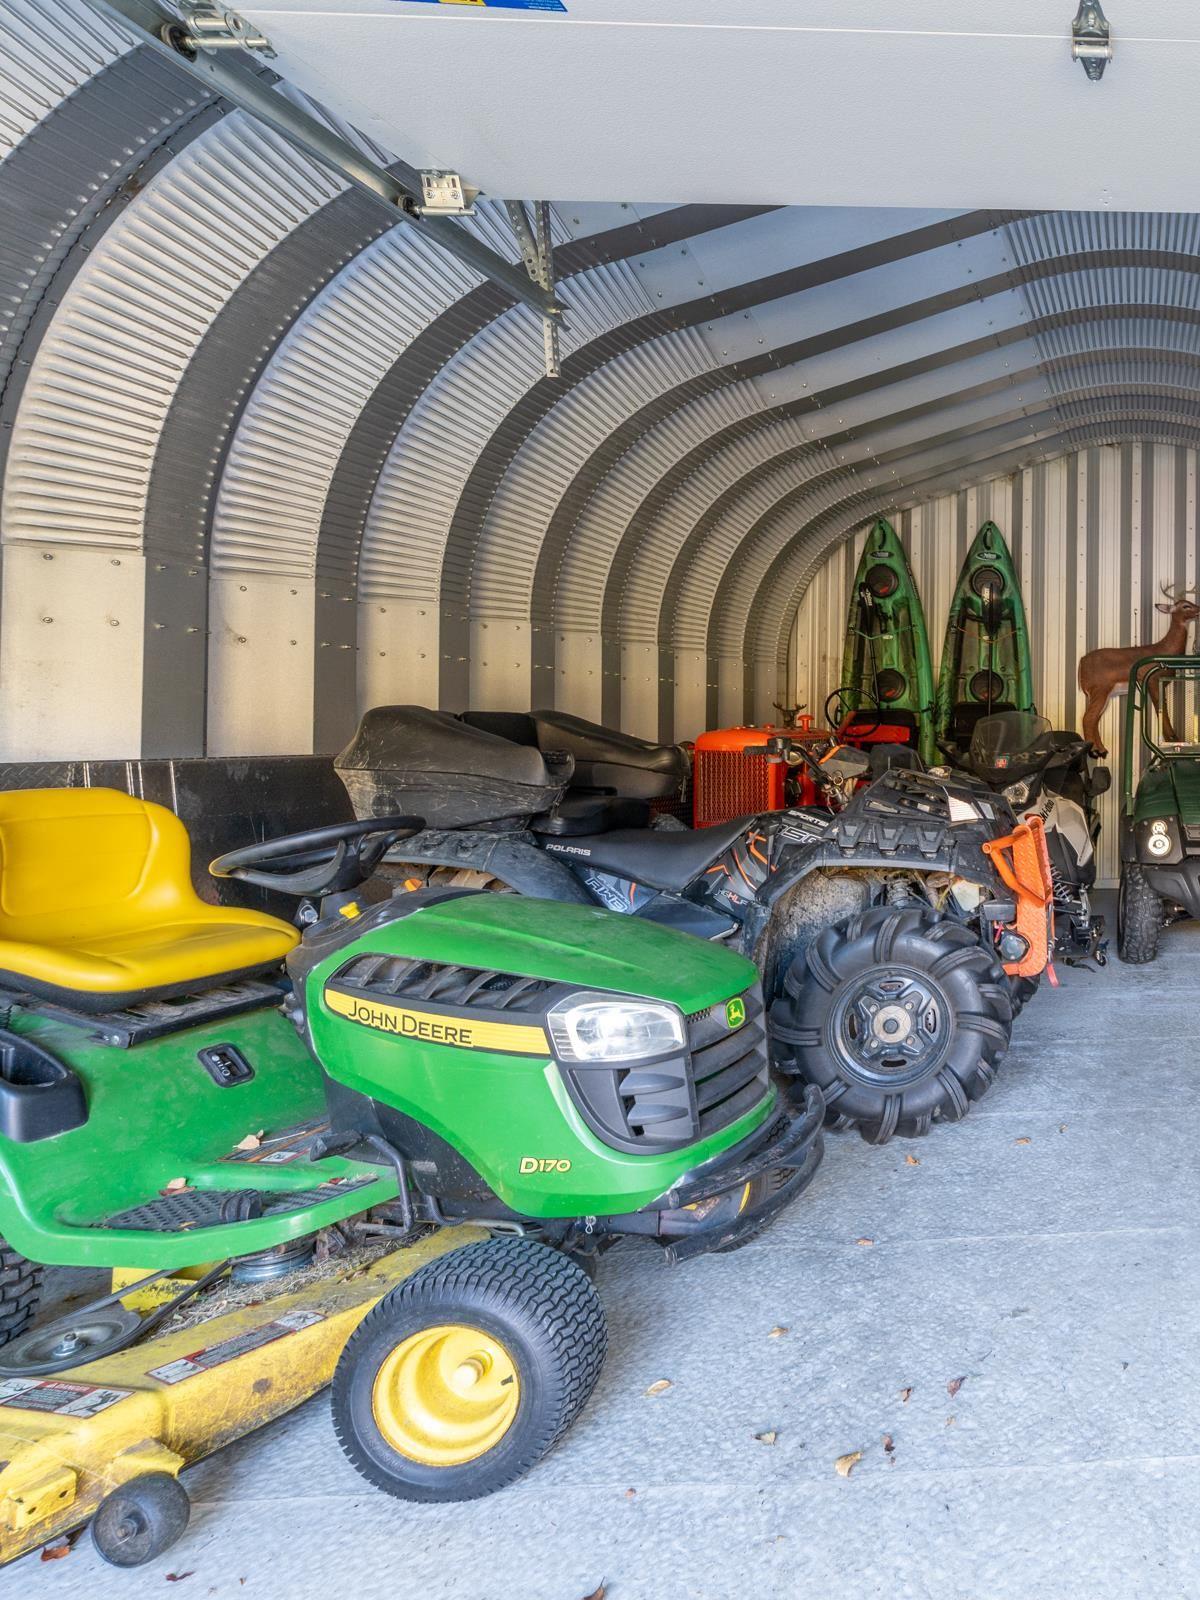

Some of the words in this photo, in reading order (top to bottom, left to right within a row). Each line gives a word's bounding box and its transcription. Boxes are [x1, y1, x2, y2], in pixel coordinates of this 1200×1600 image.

[546, 844, 591, 856] POLARIS
[348, 1000, 397, 1029] JOHN
[402, 1014, 472, 1044] DEERE
[519, 1157, 571, 1174] D170
